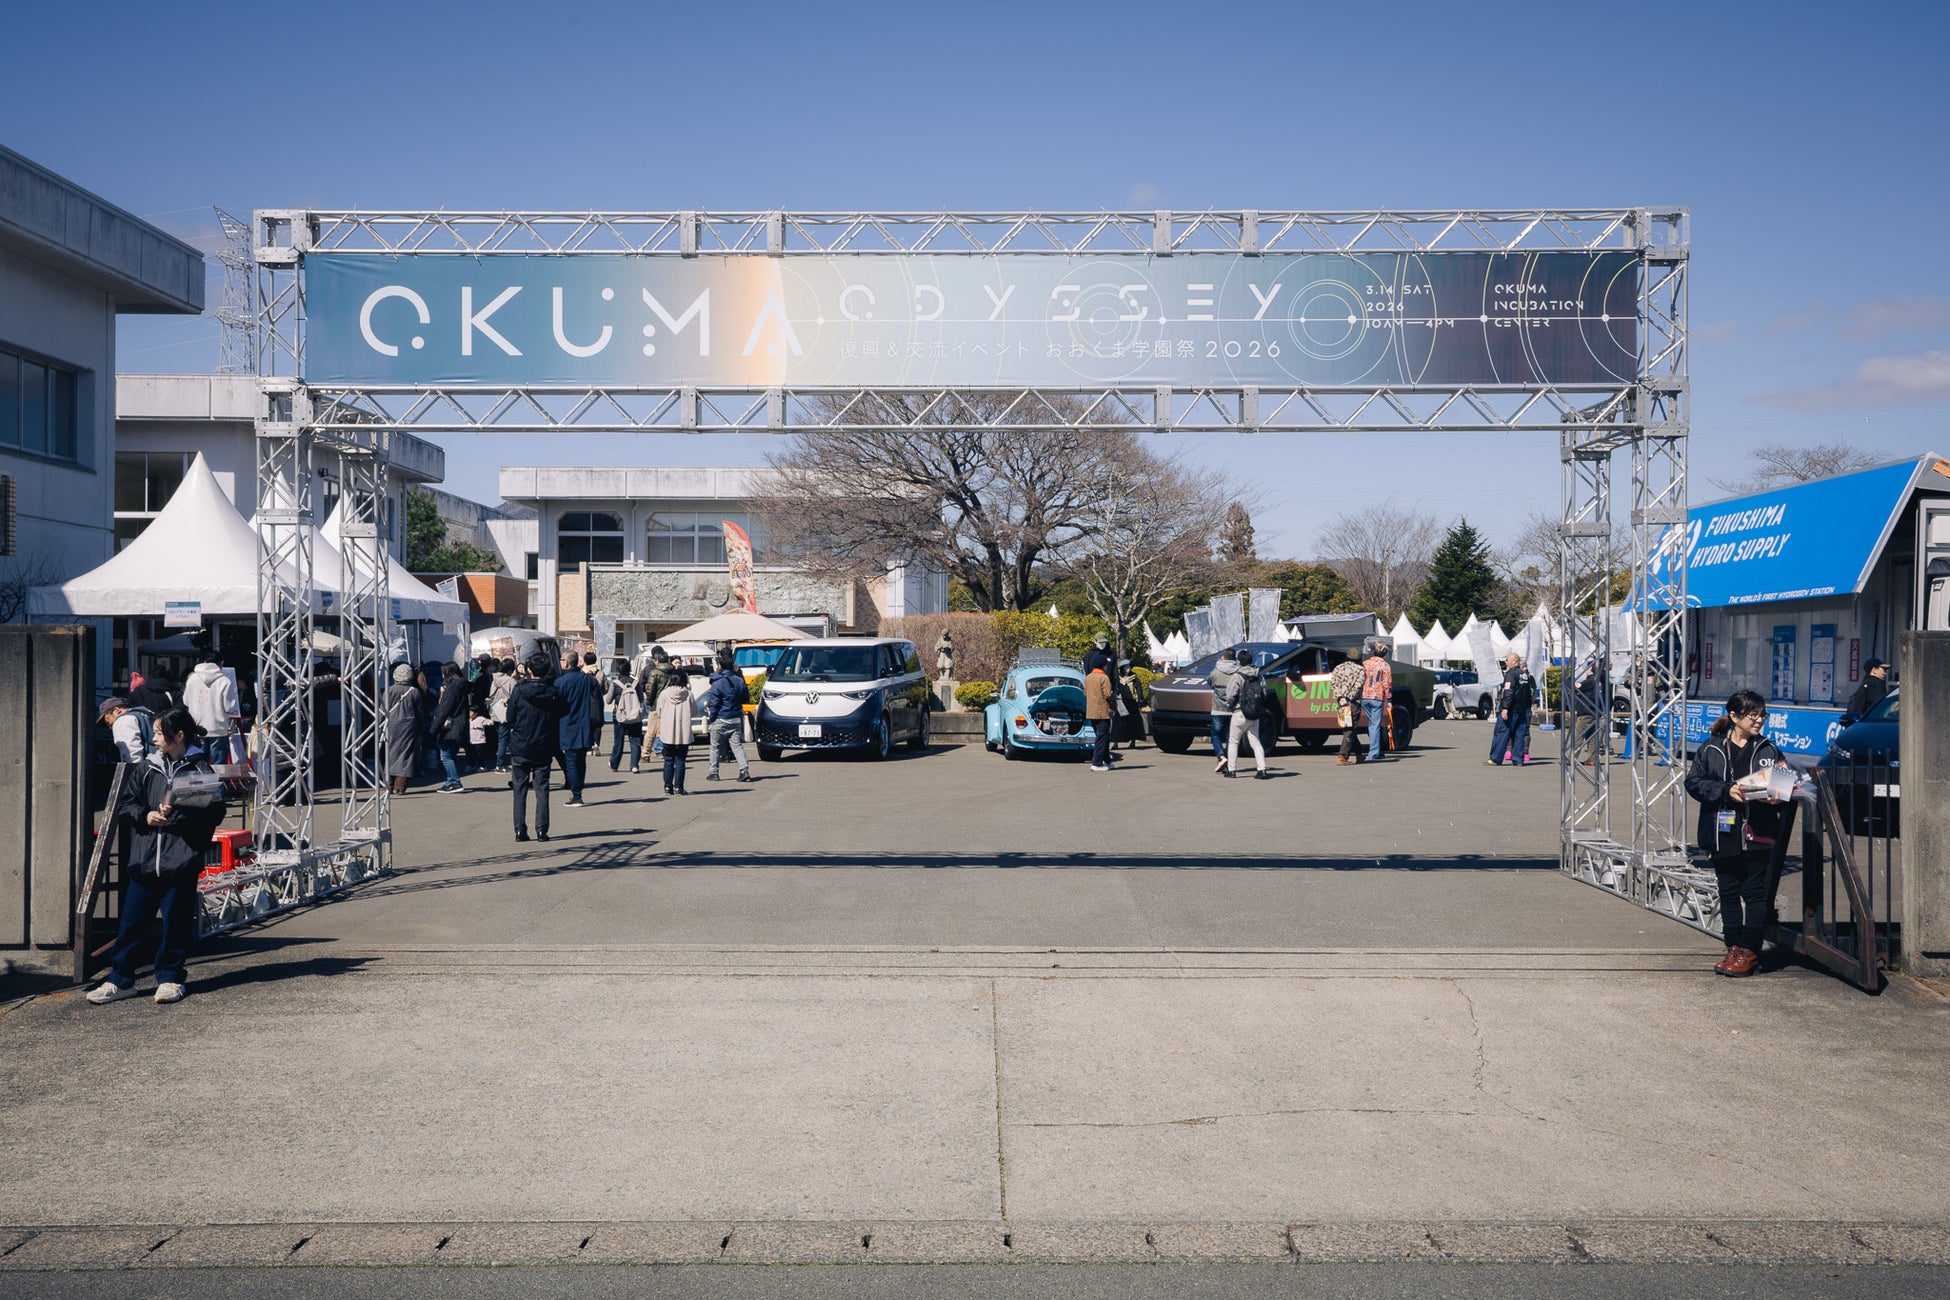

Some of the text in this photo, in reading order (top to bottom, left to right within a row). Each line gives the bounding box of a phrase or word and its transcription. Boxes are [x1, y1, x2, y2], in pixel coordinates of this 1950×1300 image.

[1366, 285, 1432, 295] 3.14 SAT
[1494, 284, 1547, 294] OKUMA
[1366, 302, 1404, 312] 2026
[1494, 301, 1584, 311] INCUBATION
[360, 284, 1283, 358] OKUMA ODYSSEY
[1494, 318, 1550, 327] CENTER
[1046, 340, 1196, 358] おおくま学園祭
[1205, 340, 1281, 358] 2026
[1704, 503, 1786, 538] FUKUSHIMA
[1690, 533, 1791, 568] HYDRO SUPPLY
[1310, 702, 1321, 714] by
[1322, 702, 1331, 711] IS
